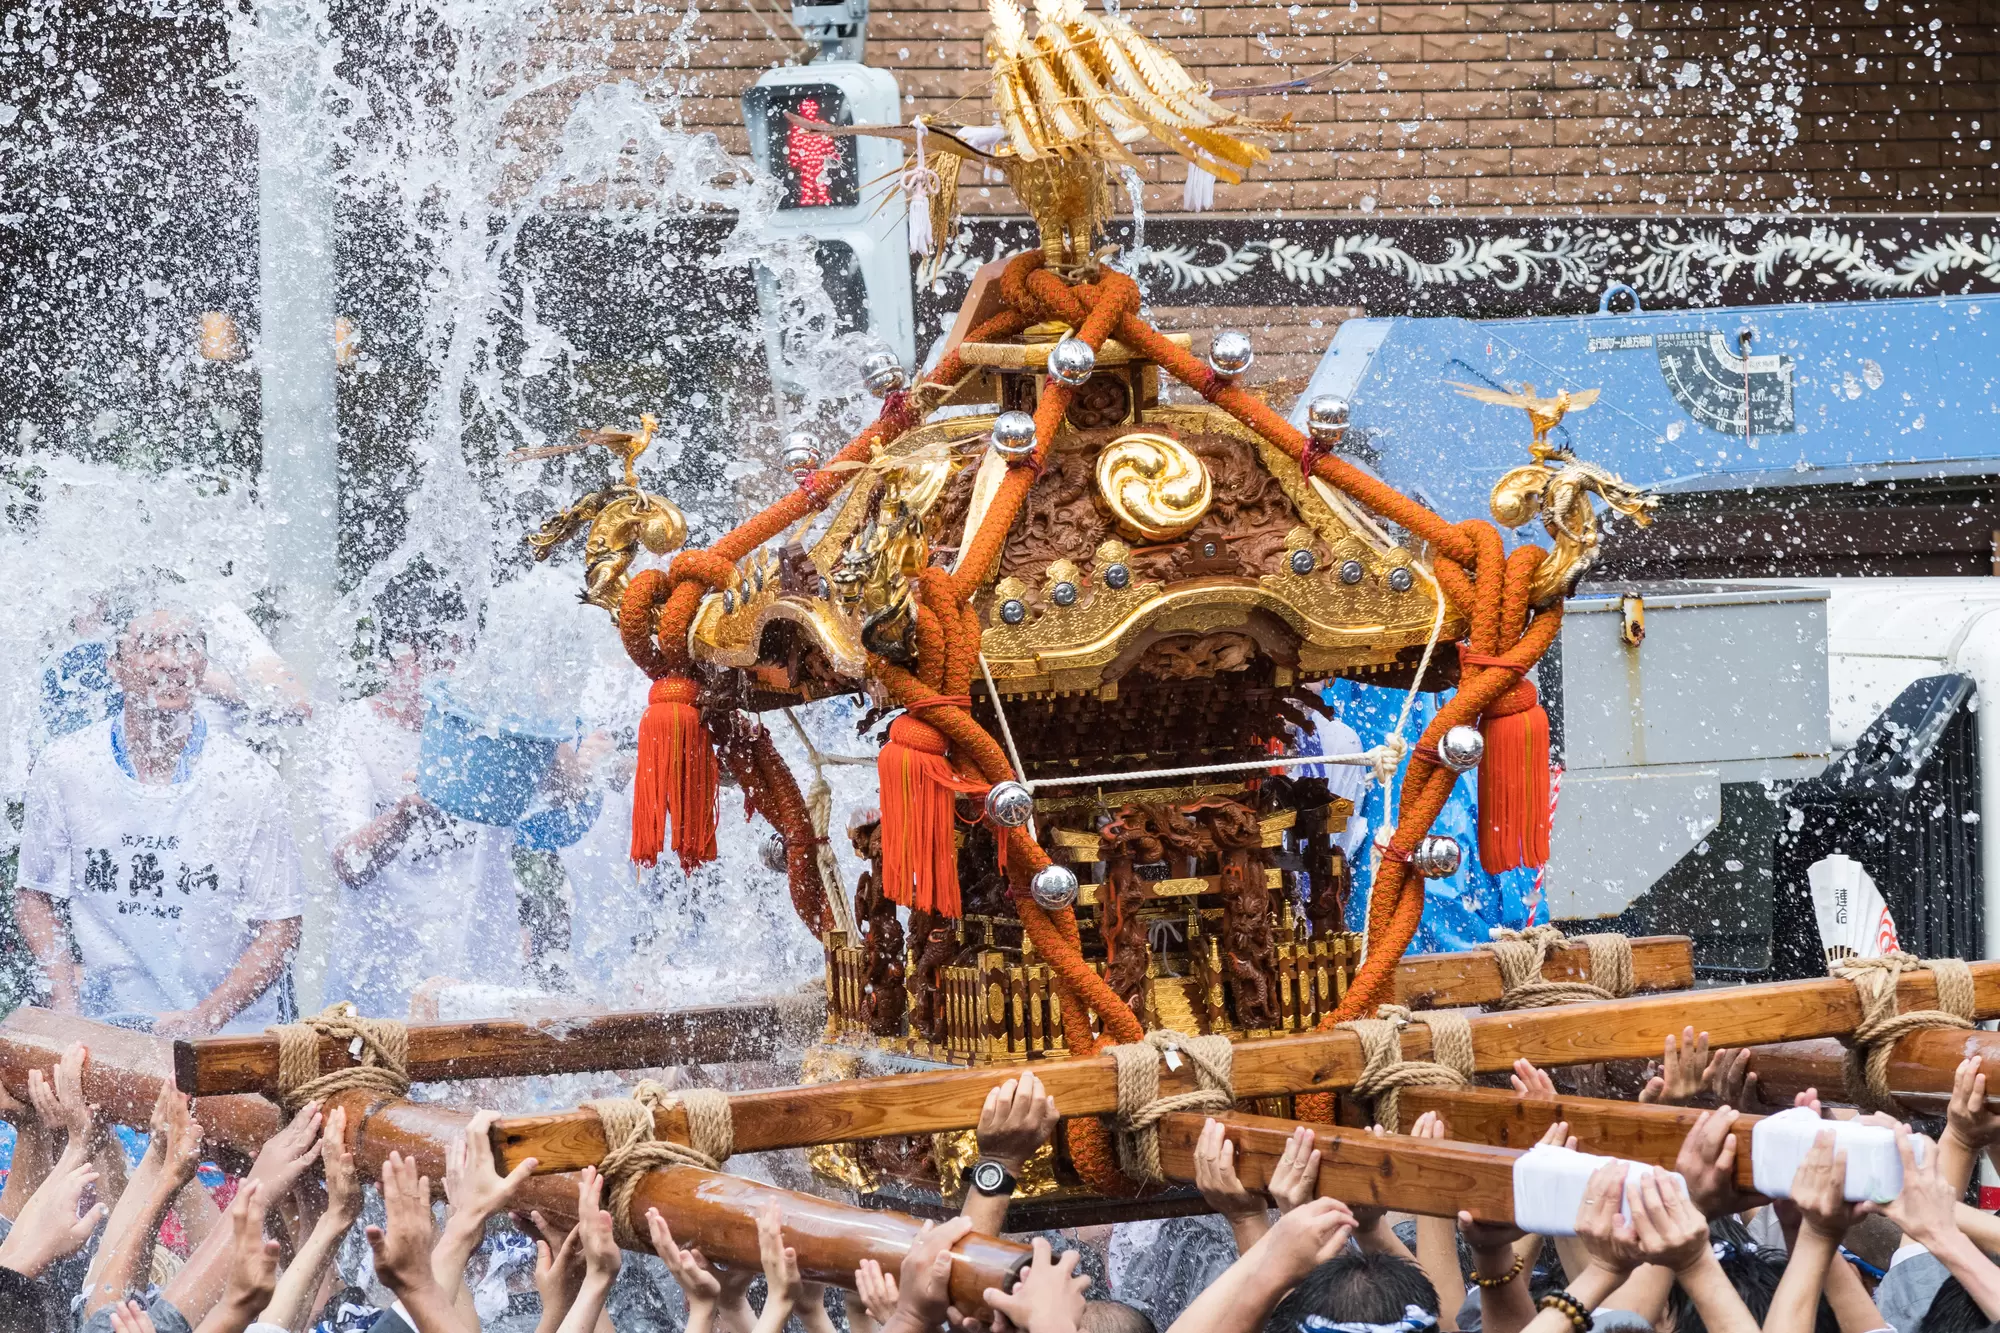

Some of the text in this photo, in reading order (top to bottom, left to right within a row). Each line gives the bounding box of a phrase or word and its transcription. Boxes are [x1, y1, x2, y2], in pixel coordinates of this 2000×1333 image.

[121, 833, 180, 850] 江戸三大祭
